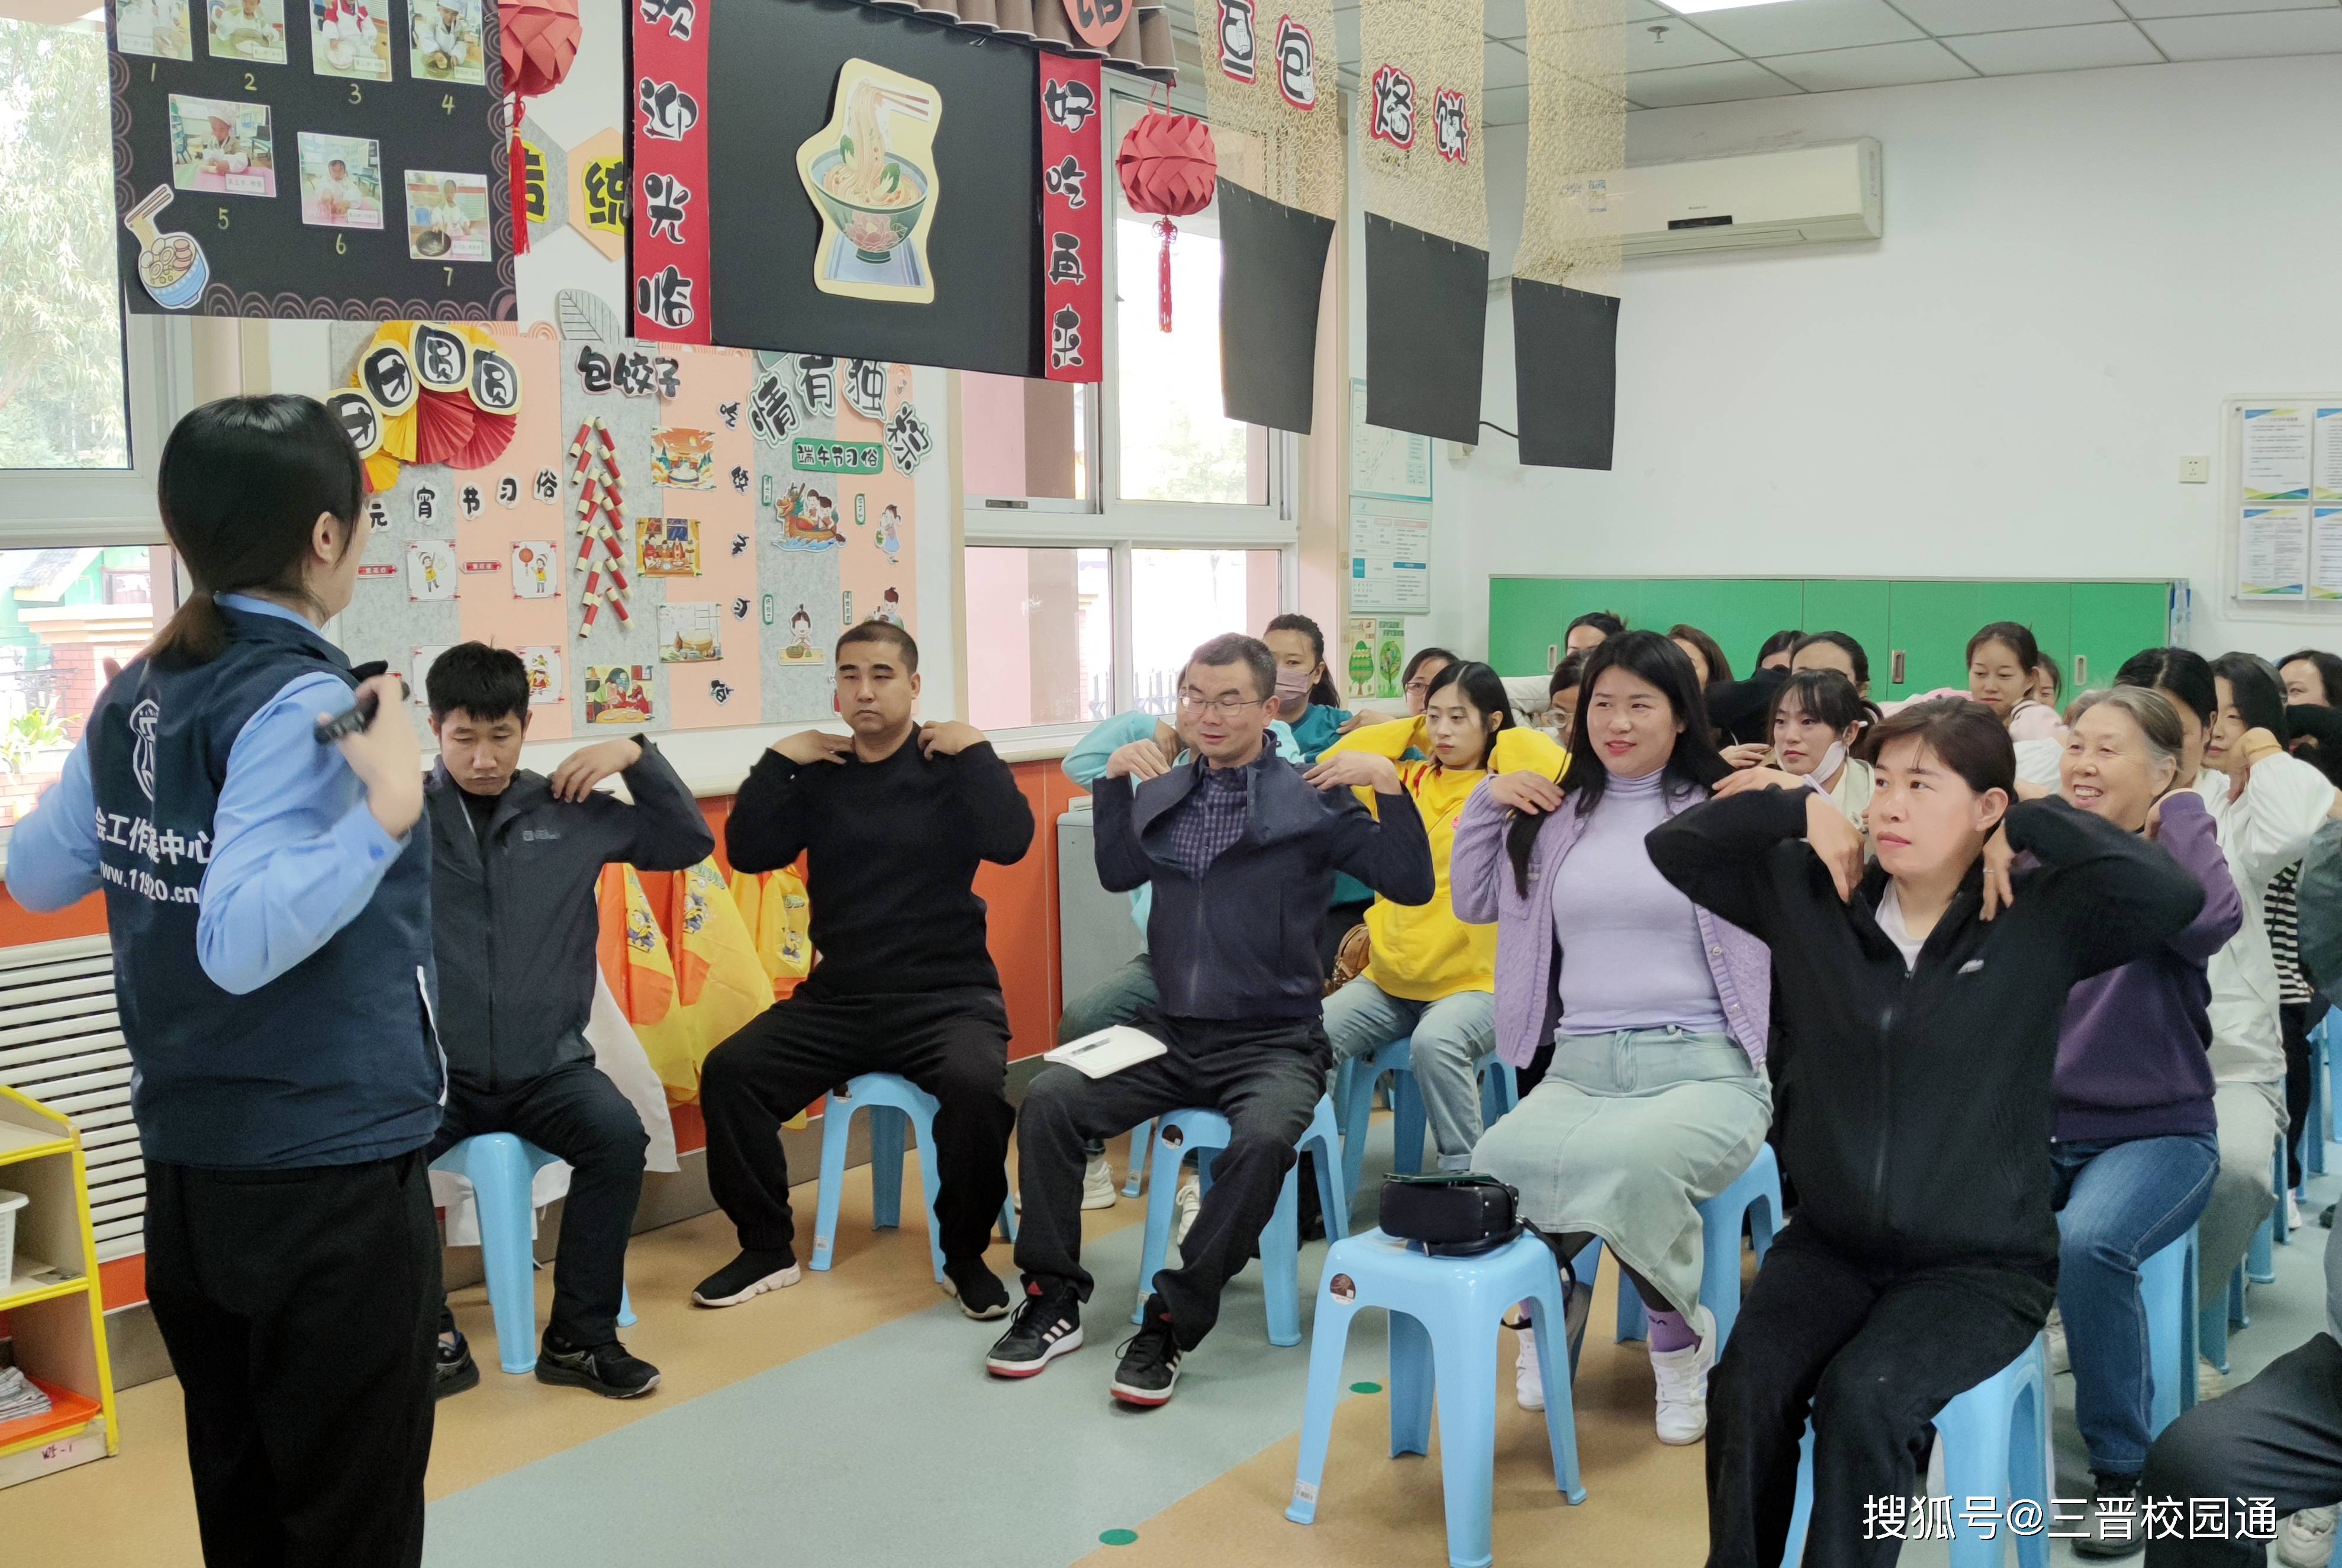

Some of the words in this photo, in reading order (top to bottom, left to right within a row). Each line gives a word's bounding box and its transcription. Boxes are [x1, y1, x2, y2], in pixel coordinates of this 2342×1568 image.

[150, 62, 156, 82] 1
[244, 73, 257, 91] 2
[348, 84, 362, 105] 3
[442, 94, 455, 115] 4
[217, 208, 230, 230] 5
[1043, 79, 1095, 368] 好吃再来
[334, 234, 346, 255] 6
[442, 267, 453, 286] 7
[578, 345, 681, 398] 包饺子
[327, 324, 518, 451] 团团圆圆
[752, 355, 929, 471] 情有独粽
[797, 445, 878, 468] 端午节习俗
[371, 469, 558, 529] 元宵节习俗
